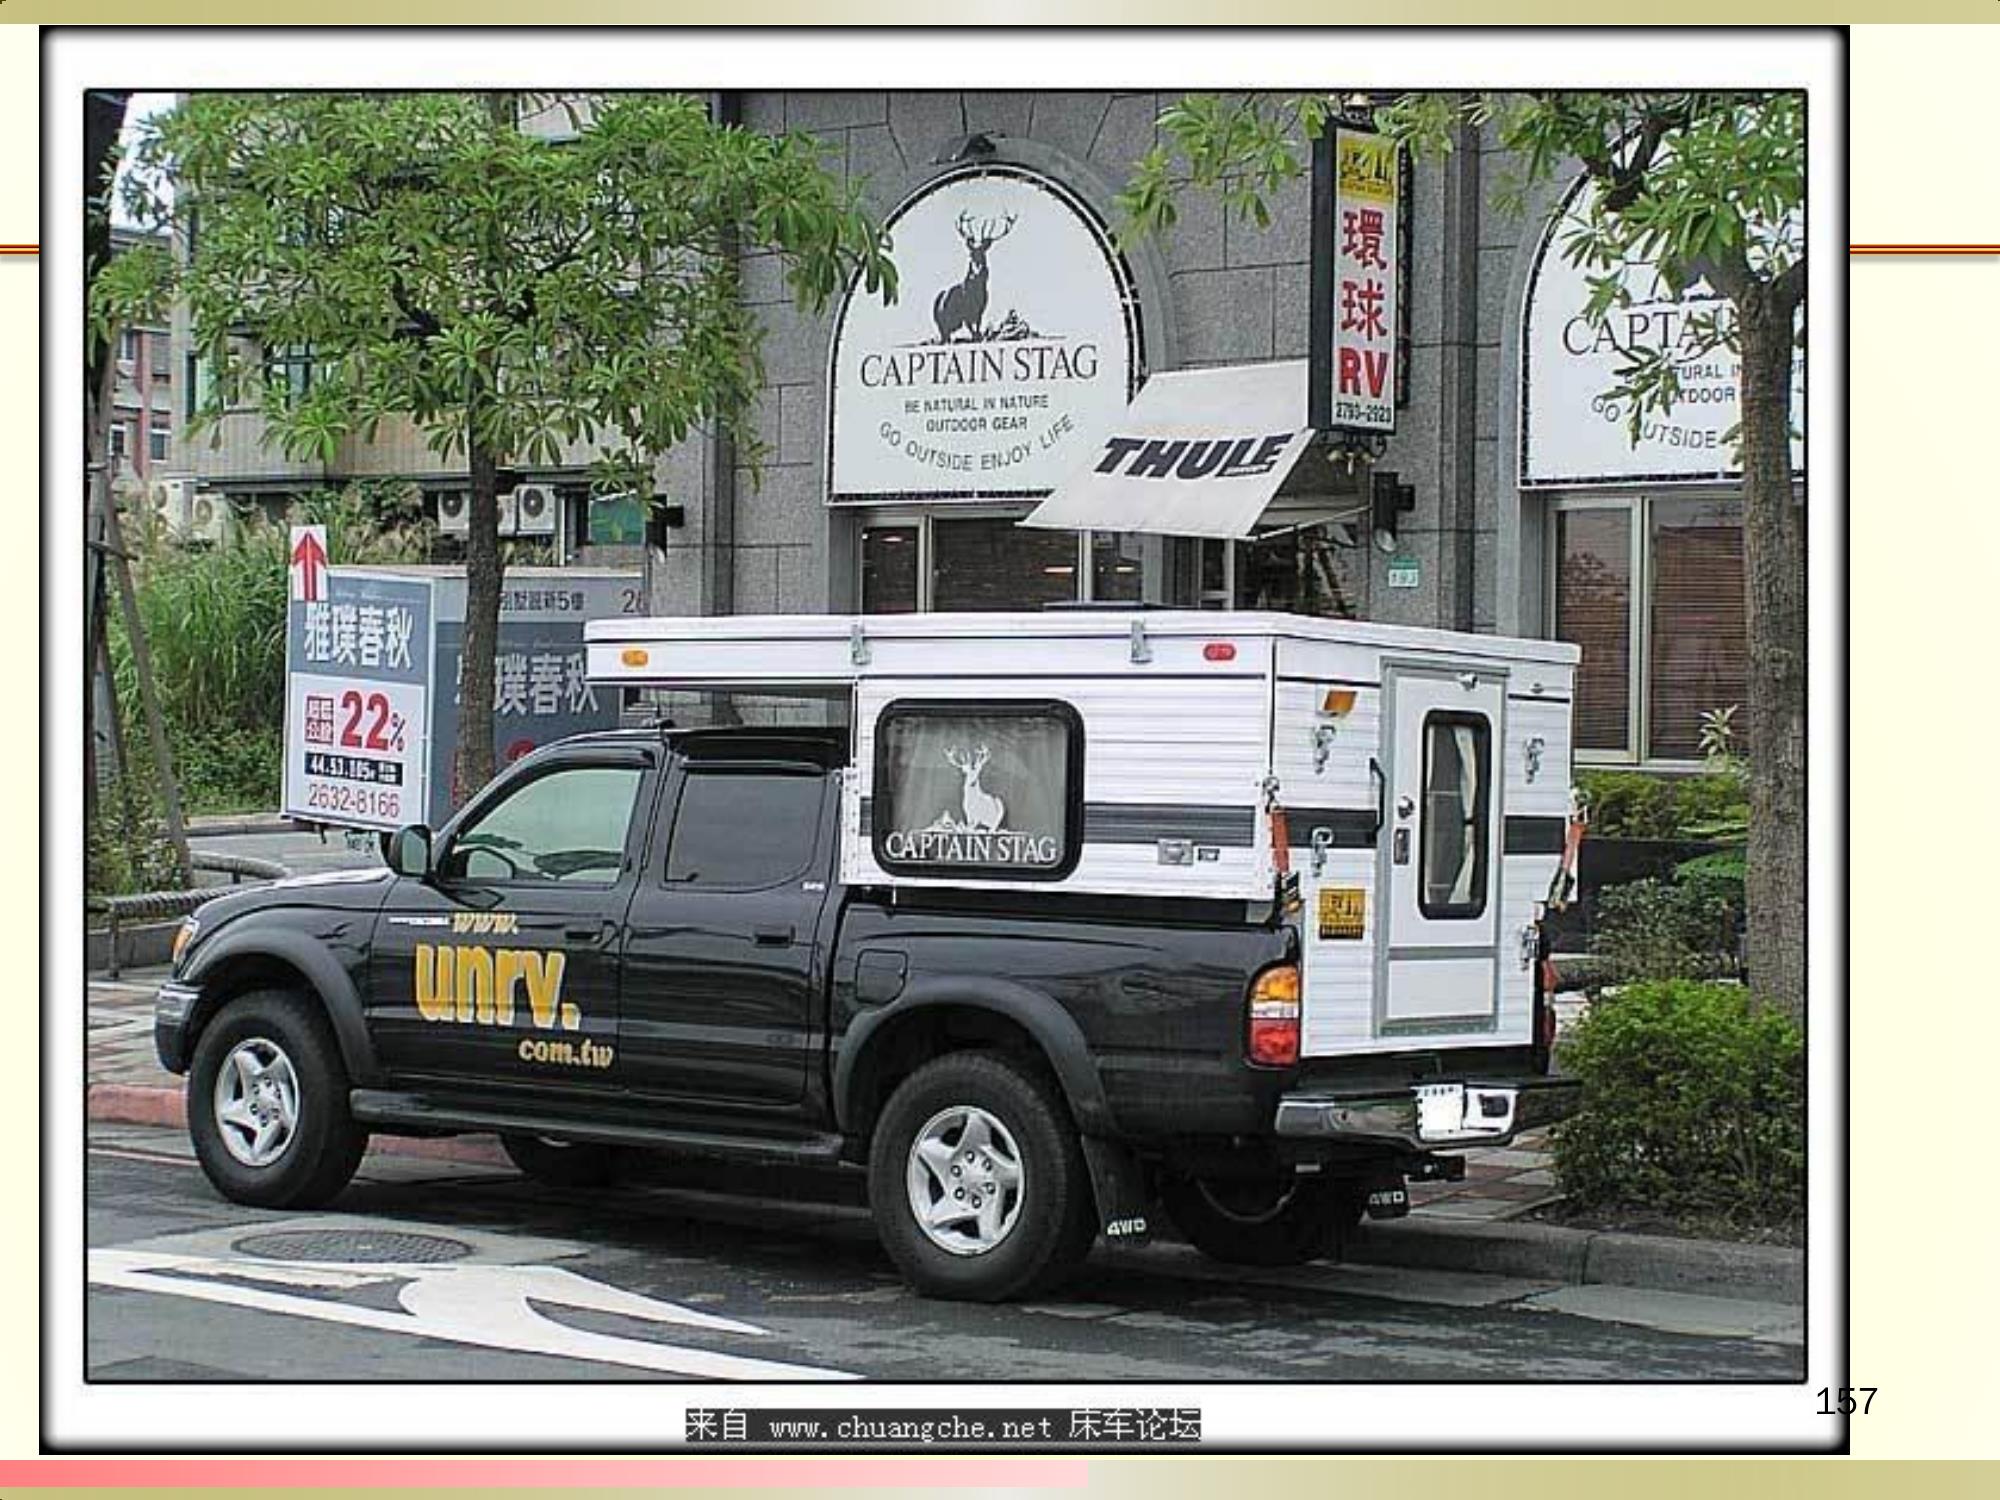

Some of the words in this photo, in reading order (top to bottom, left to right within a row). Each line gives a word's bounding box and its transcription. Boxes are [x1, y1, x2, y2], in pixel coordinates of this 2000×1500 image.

[1341, 208, 1387, 341] 環球
[860, 349, 1004, 387] CAPTAIN
[1014, 345, 1098, 381] STAG
[1340, 347, 1388, 398] RV
[905, 399, 919, 413] BE
[924, 397, 978, 413] NATURAL
[983, 396, 996, 410] IN
[1000, 395, 1049, 409] NATURE
[926, 417, 987, 432] OUTDOOR
[992, 416, 1027, 430] GEAR
[1591, 396, 1621, 422] GO
[1638, 419, 1718, 449] UTSIDE
[880, 421, 901, 446] GO
[906, 440, 973, 471] OUTSIDE
[981, 442, 1033, 471] ENJOY
[1040, 413, 1075, 449] LIFE
[1094, 432, 1294, 479] THULE
[340, 690, 406, 752] 22%
[308, 782, 401, 818] 2632-8166
[886, 831, 992, 861] CAPTAIN
[994, 836, 1057, 863] STAG
[415, 943, 583, 1031] unrv.
[518, 1038, 614, 1068] com.tw
[1107, 1218, 1146, 1235] 4WD
